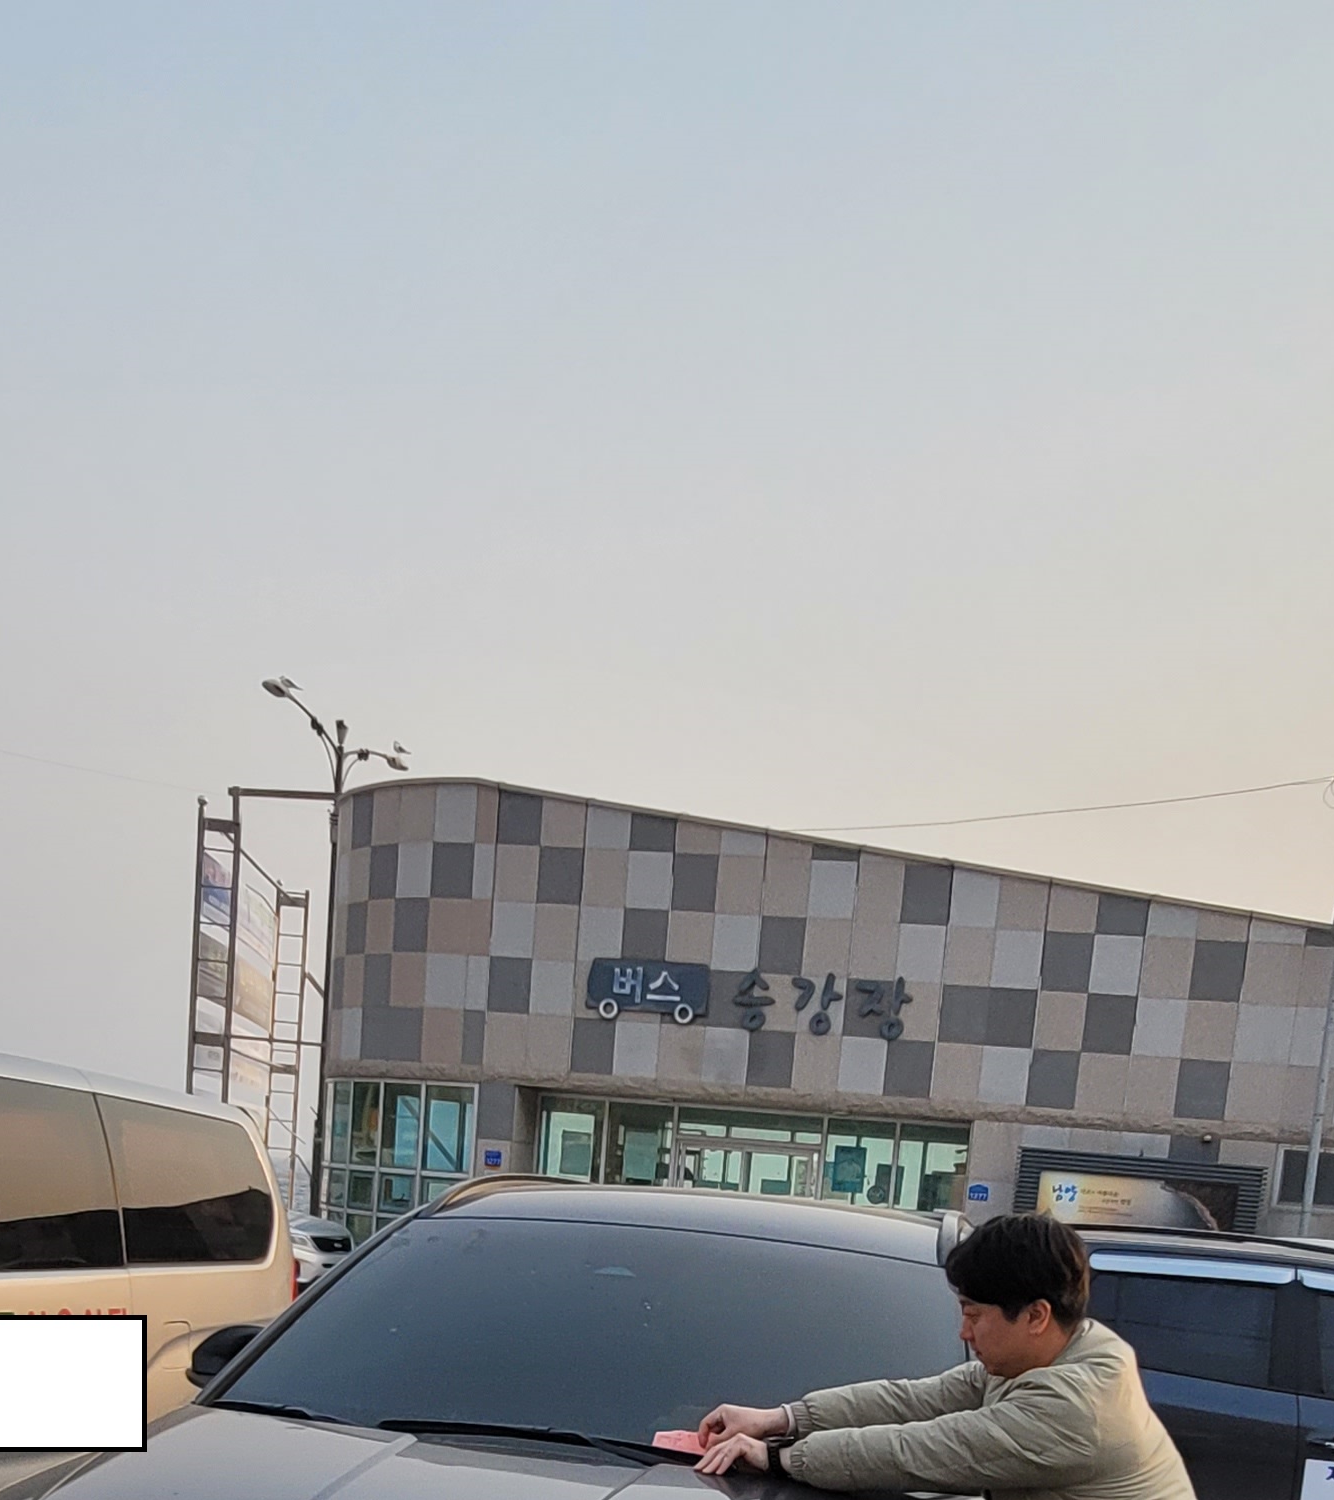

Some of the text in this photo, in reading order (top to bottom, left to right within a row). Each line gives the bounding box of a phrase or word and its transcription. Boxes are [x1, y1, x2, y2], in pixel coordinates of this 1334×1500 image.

[612, 966, 913, 1040] 버스 승강장
[1052, 1184, 1078, 1202] 남양
